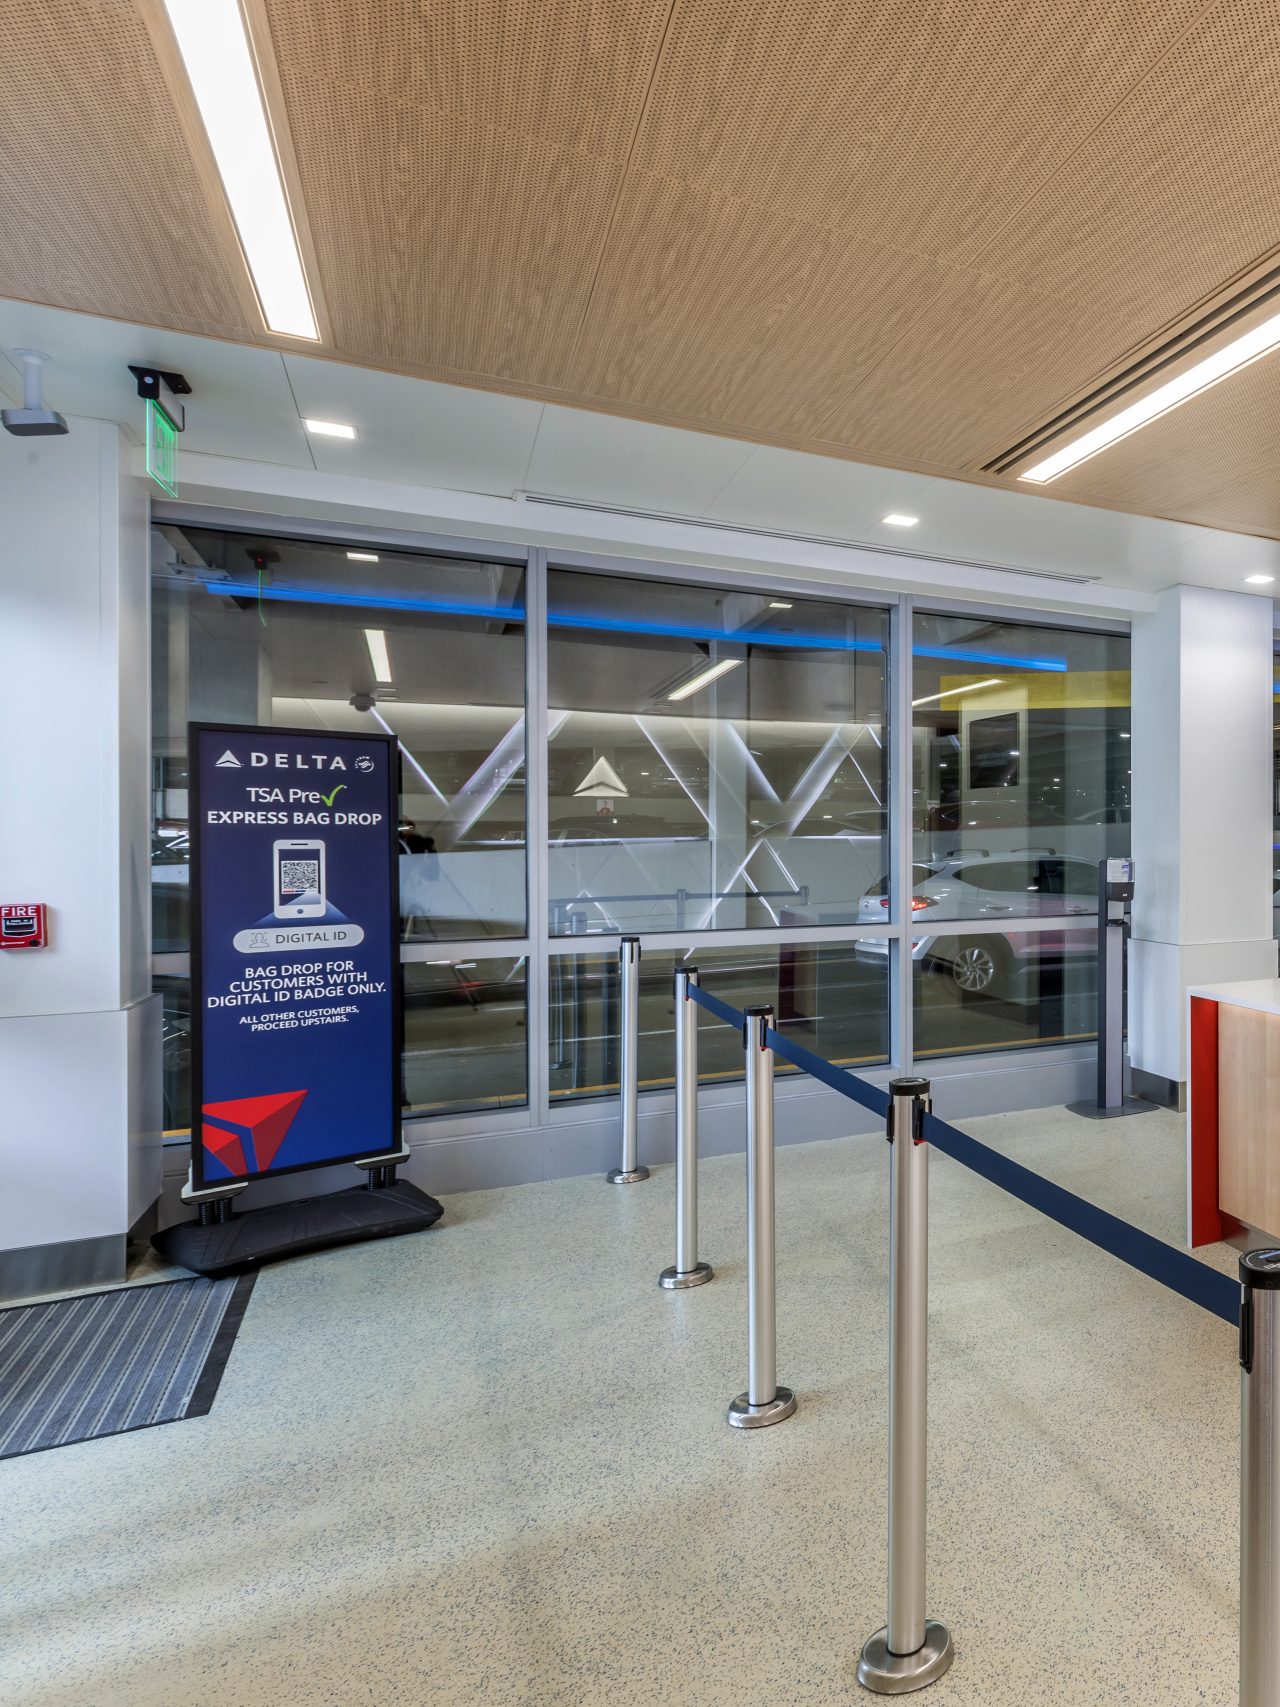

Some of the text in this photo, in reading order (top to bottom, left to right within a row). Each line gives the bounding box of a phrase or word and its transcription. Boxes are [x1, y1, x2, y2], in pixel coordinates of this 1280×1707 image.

[251, 751, 347, 771] DELTA
[246, 787, 320, 804] TSA Pre
[207, 811, 382, 826] EXPRESS BAG DROP
[1, 906, 37, 917] FIRE
[275, 931, 347, 944] DIGITAL ID
[245, 960, 354, 979] BAG DROP FOR
[229, 971, 367, 993] CUSTOMERS WITH
[207, 982, 386, 1008] DIGITAL ID BADGE ONLY.
[239, 1005, 360, 1025] ALL OTHER CUSTOMERS,
[251, 1015, 349, 1032] PROCEED UPSTAIRS.
